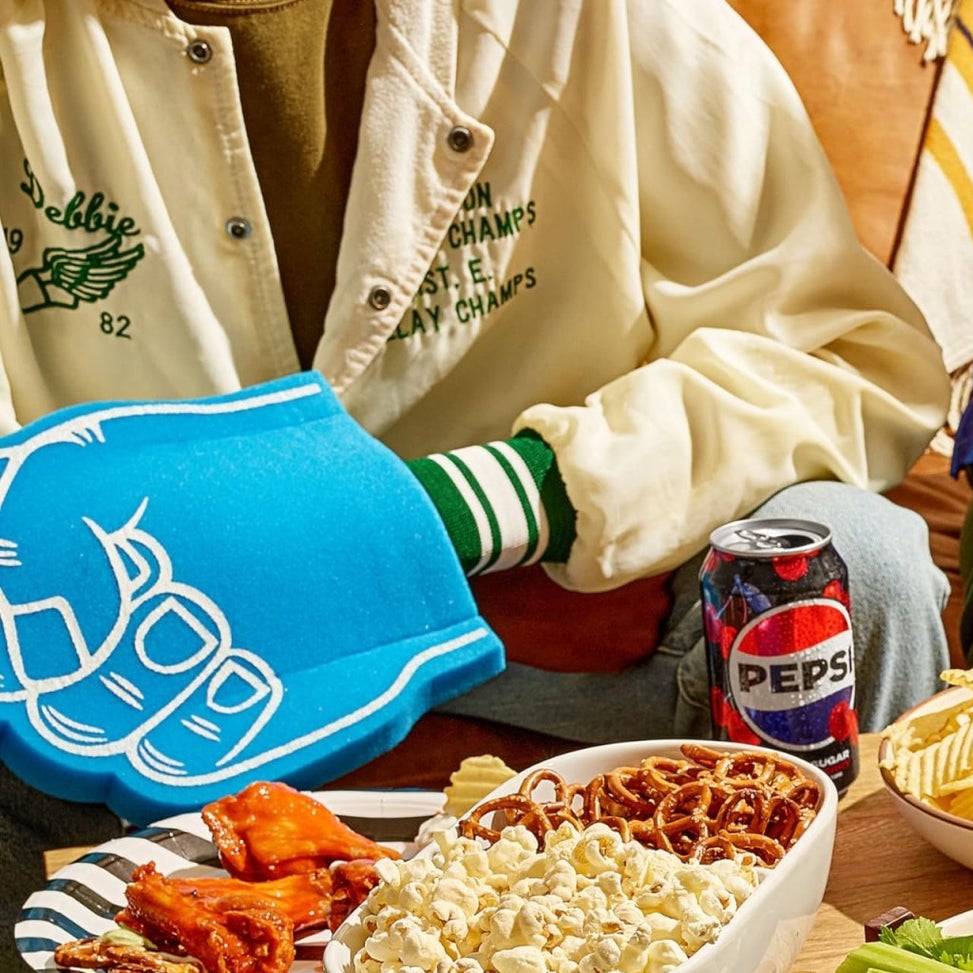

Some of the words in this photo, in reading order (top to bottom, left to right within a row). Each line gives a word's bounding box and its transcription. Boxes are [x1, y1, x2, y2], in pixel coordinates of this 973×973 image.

[20, 158, 141, 236] Debbie
[448, 200, 536, 249] CHAMPS
[418, 265, 460, 295] ST.
[468, 258, 493, 284] E.
[455, 267, 537, 324] CHAMPS
[99, 311, 132, 340] 82
[737, 644, 852, 694] PEPSI
